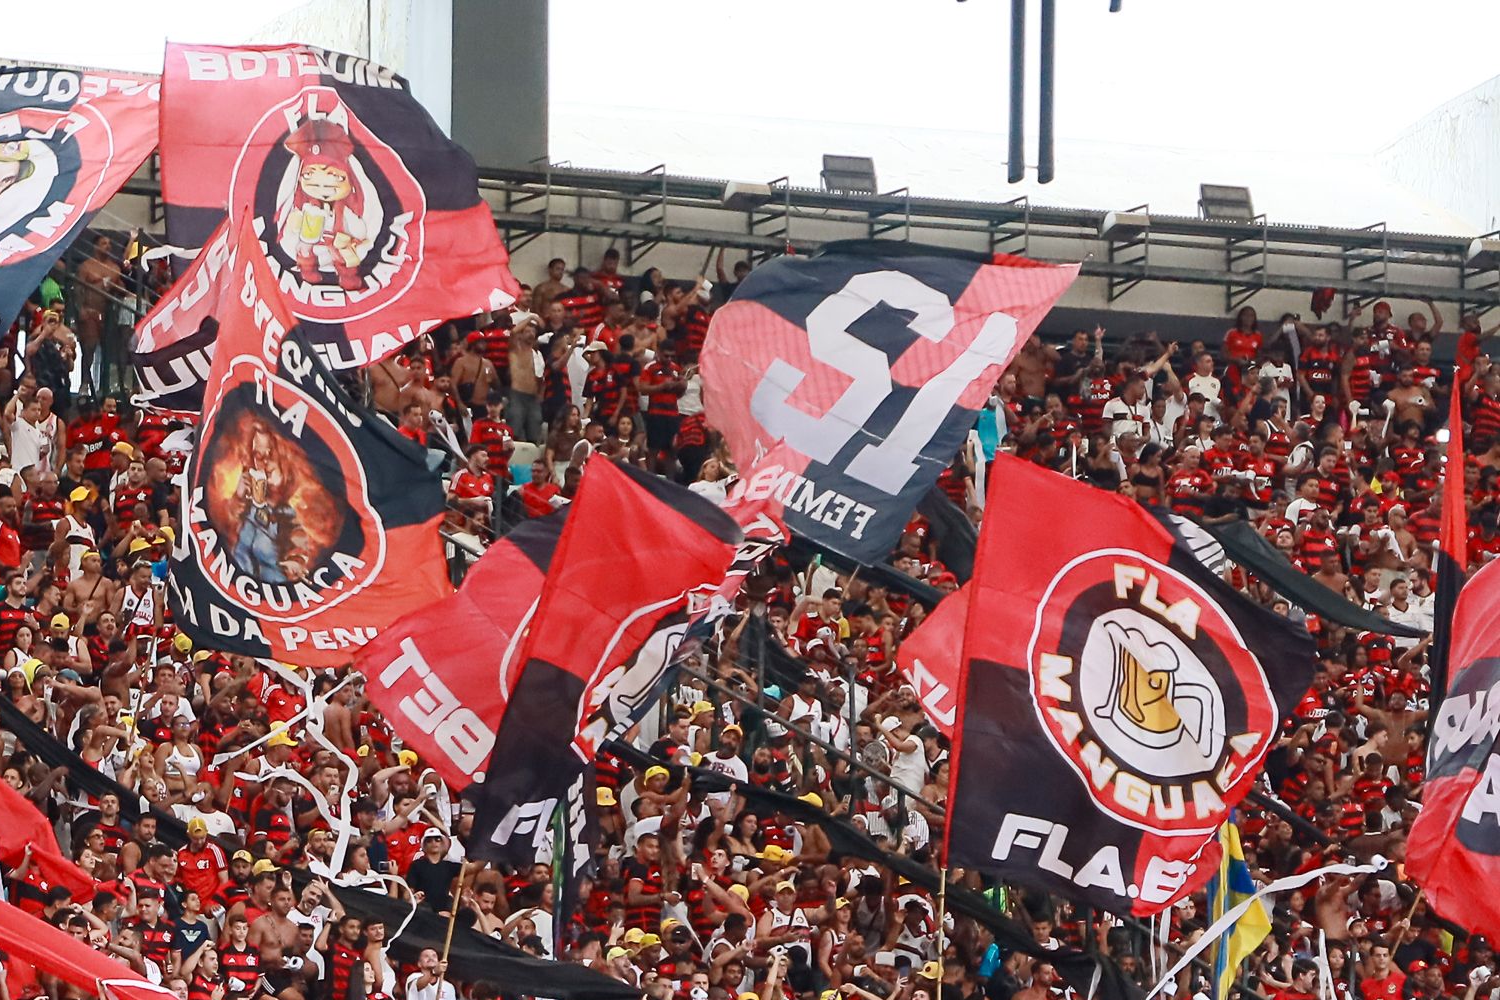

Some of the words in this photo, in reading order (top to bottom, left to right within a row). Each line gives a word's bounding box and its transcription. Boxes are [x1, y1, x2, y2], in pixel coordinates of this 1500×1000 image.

[284, 93, 350, 136] FLA
[1114, 563, 1201, 640] FLA
[209, 603, 272, 646] DA
